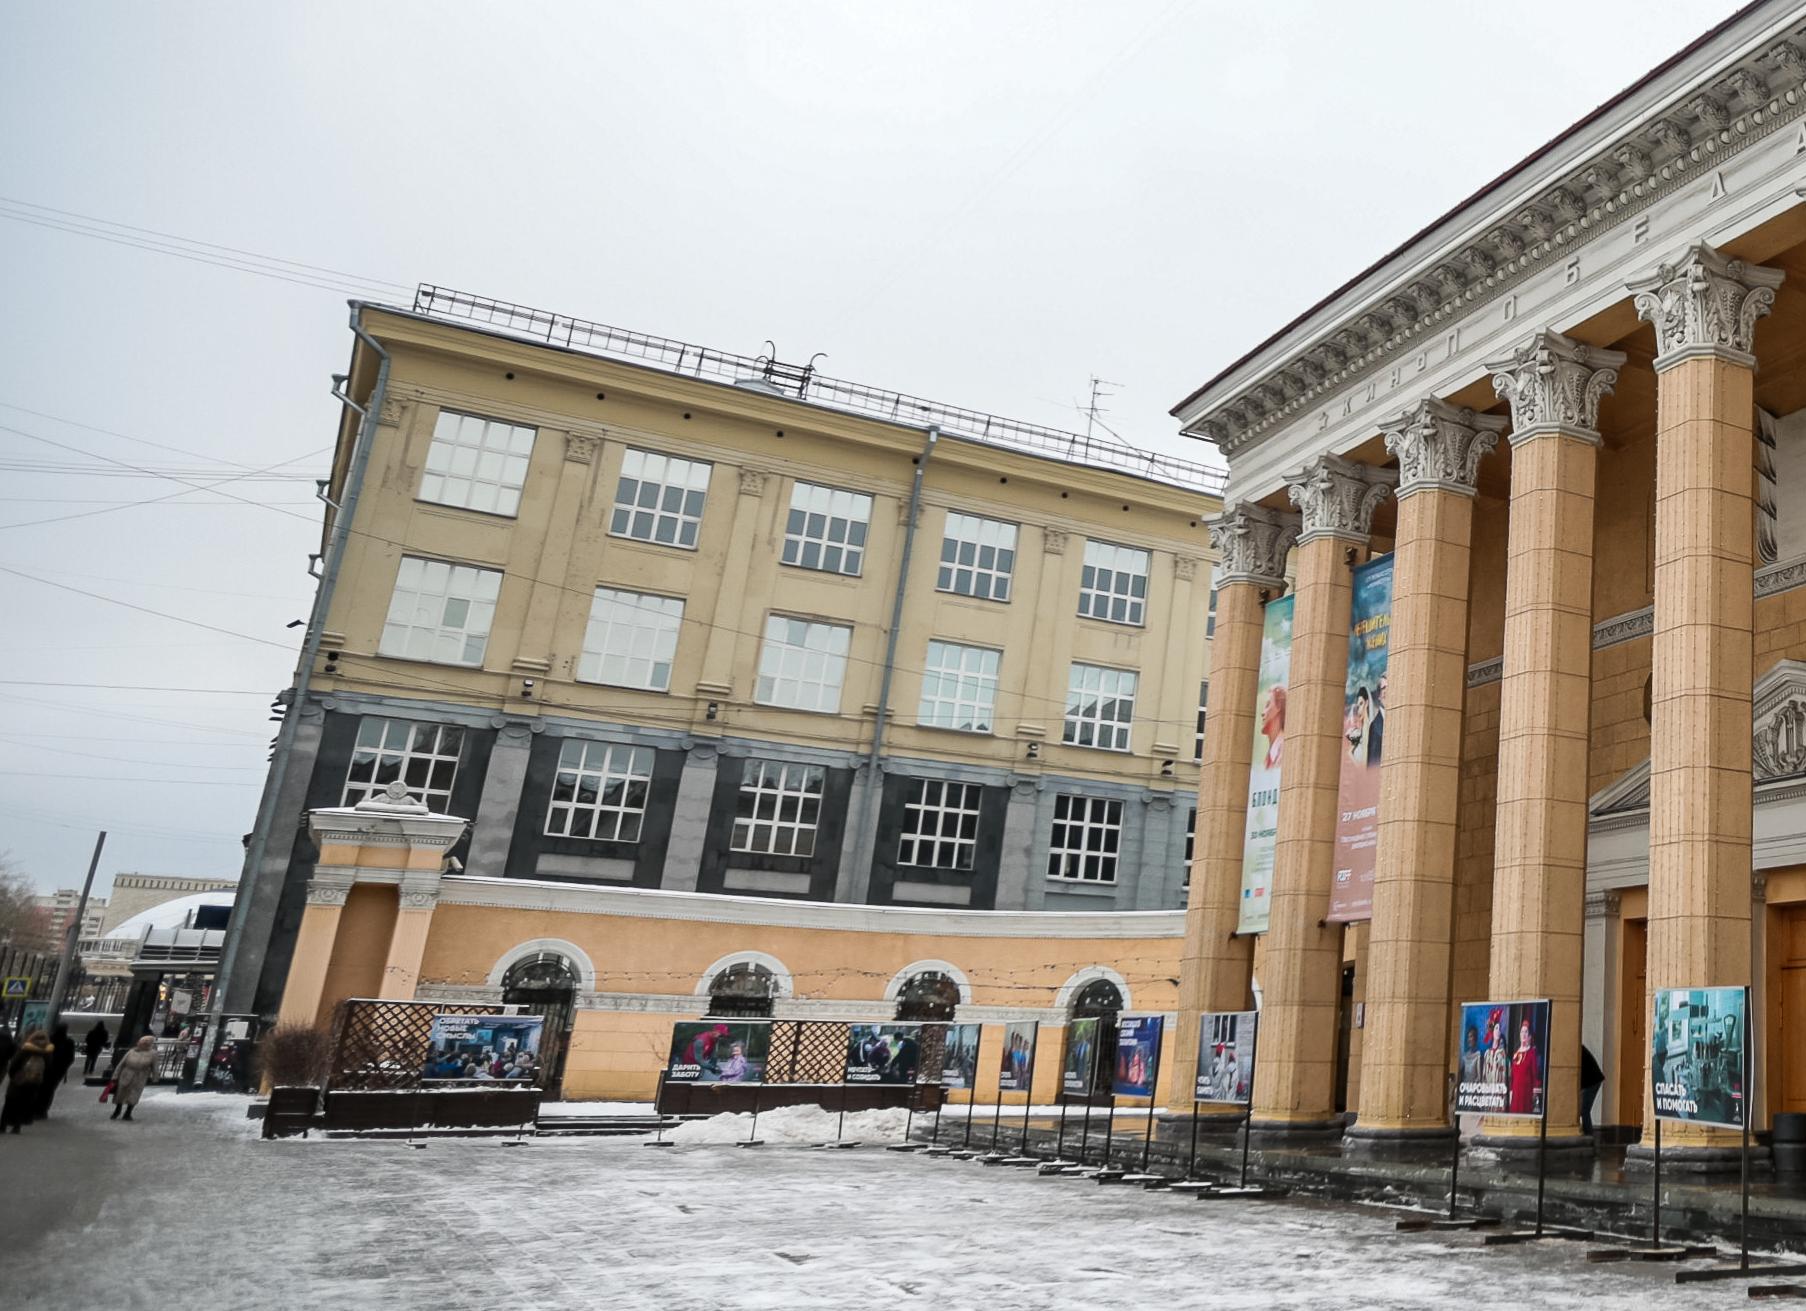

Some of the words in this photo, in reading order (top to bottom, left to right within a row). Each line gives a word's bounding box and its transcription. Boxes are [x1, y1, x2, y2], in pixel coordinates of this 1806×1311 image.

[671, 1063, 701, 1071] ДАРИТЬ
[1459, 1082, 1508, 1095] ОЧАРОВЫВАТЬ
[1655, 1082, 1687, 1096] СПАСАТЬ
[1458, 1095, 1464, 1106] И
[1464, 1095, 1505, 1108] РАСЦВЕТАТЬ
[1656, 1099, 1662, 1109] И
[1662, 1098, 1698, 1113] ПОМОГАТЬ
